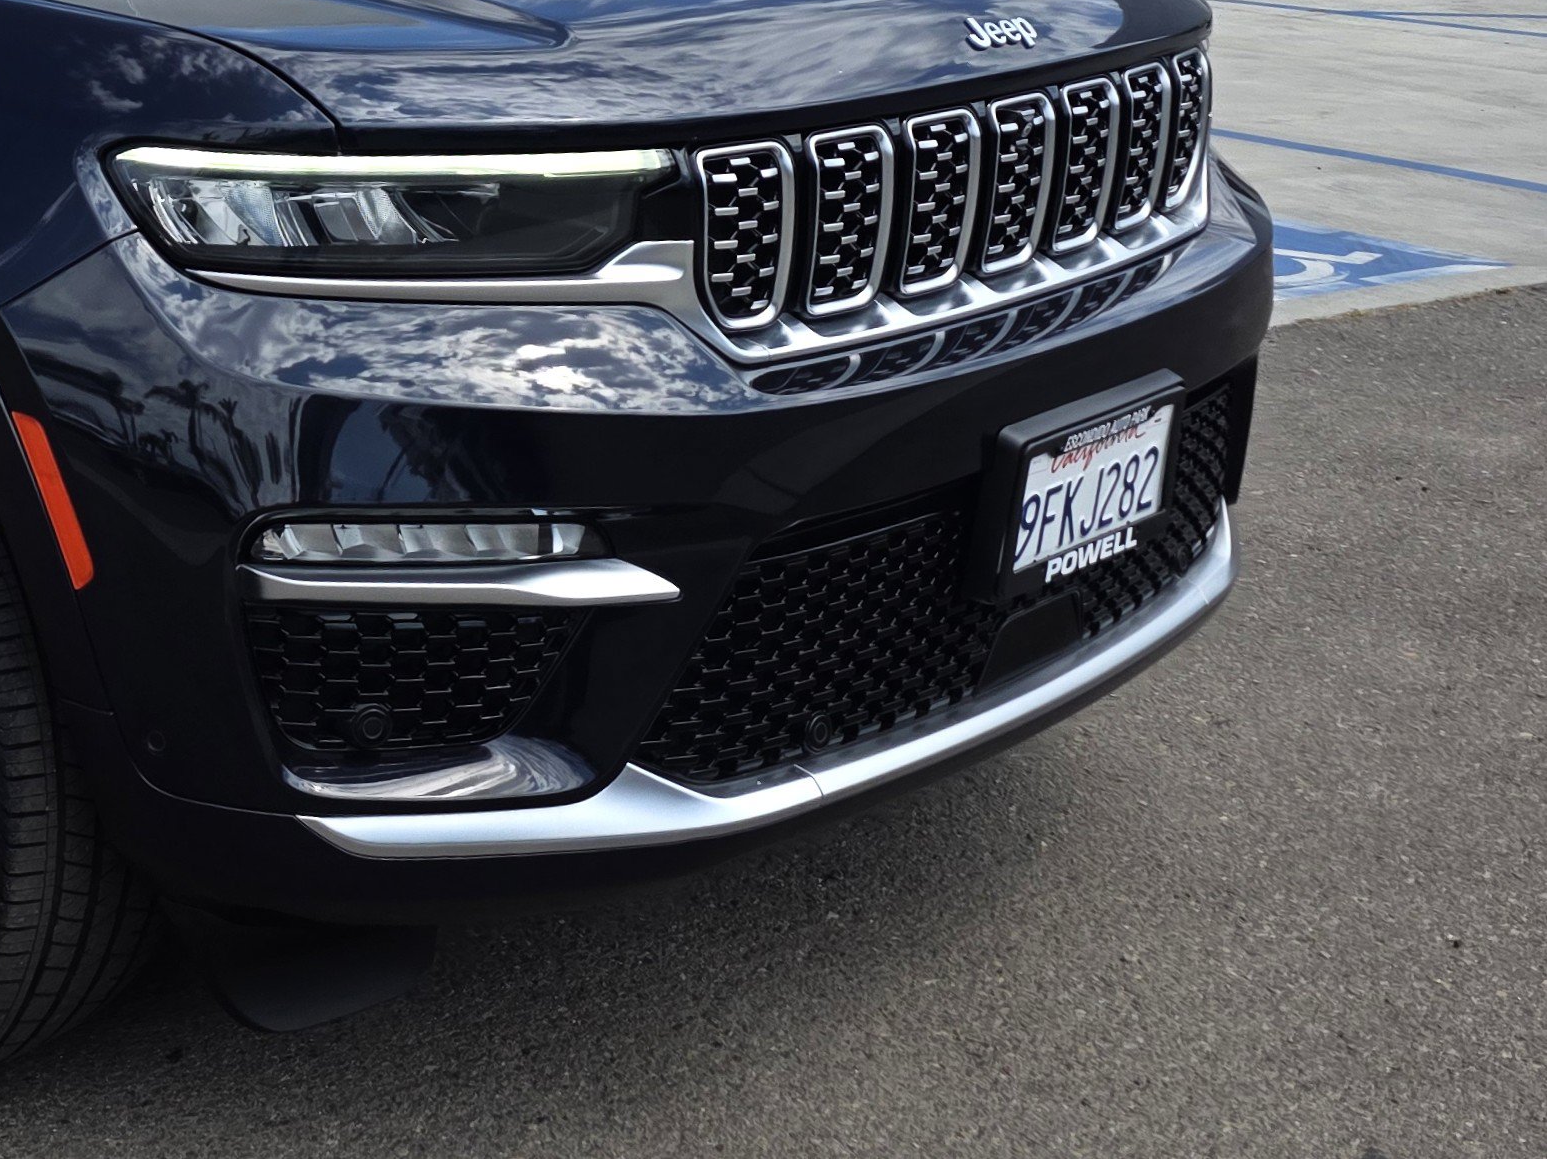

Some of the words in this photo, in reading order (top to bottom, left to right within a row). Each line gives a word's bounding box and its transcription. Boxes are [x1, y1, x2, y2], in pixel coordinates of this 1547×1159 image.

[965, 16, 1038, 51] Jeep
[1014, 445, 1159, 563] 9FKJ282
[1045, 526, 1138, 583] POWELL
